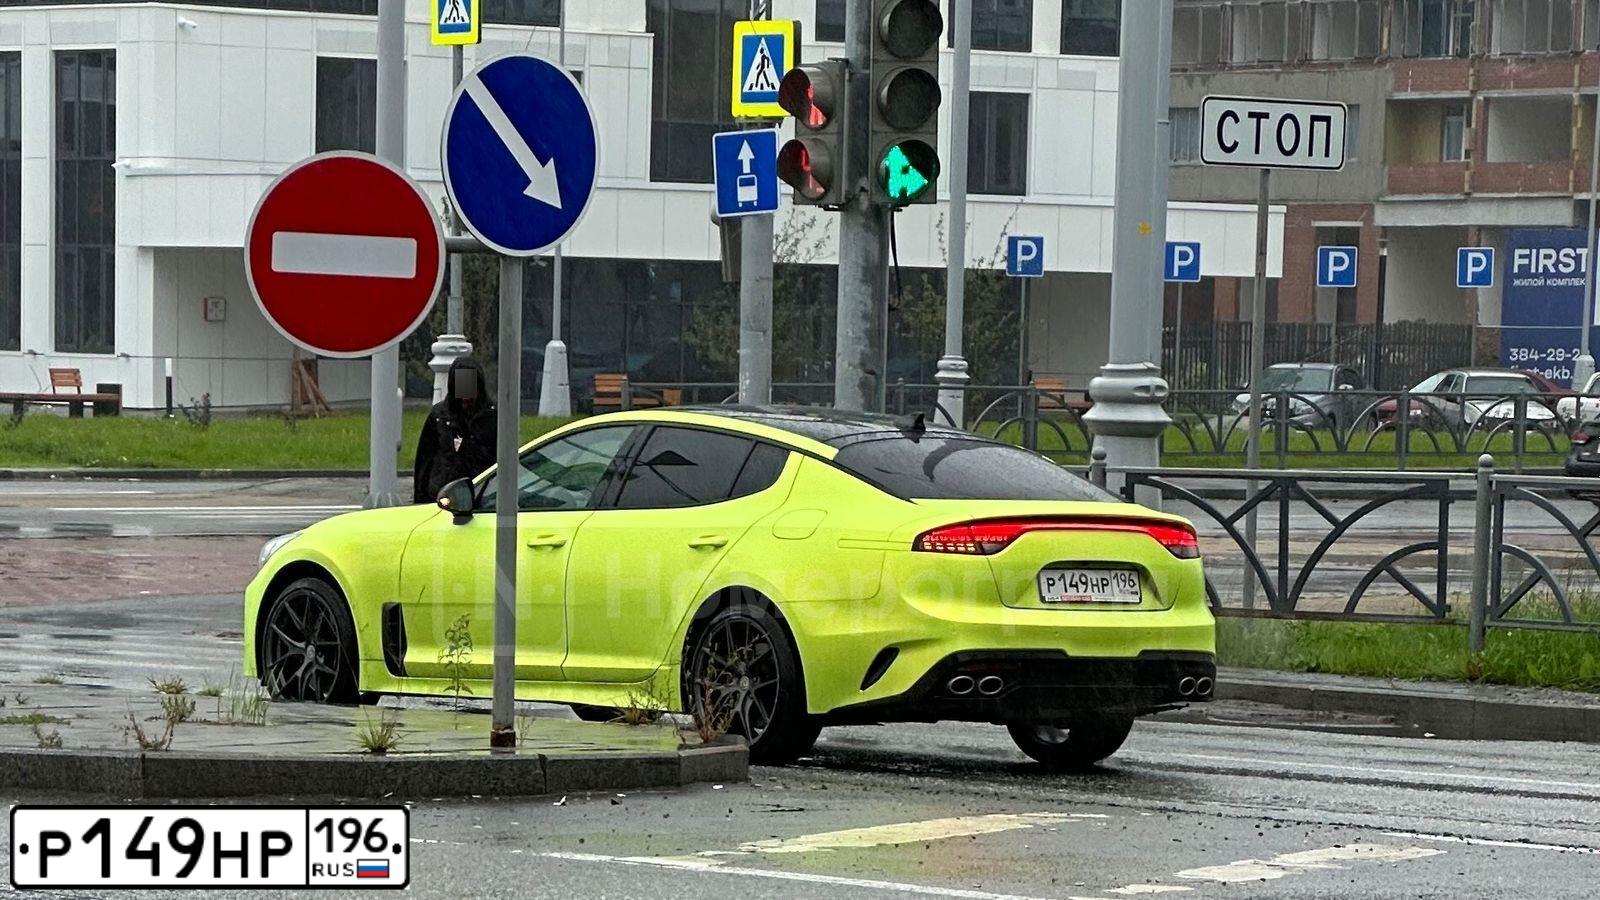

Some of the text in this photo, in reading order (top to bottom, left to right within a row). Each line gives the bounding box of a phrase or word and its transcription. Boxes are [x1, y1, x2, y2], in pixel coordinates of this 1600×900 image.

[1217, 110, 1331, 158] СТОП
[1017, 240, 1037, 271] P
[1173, 246, 1194, 276] P
[1328, 251, 1349, 282] P
[1467, 252, 1487, 282] P
[1513, 248, 1588, 273] FIRST
[1513, 277, 1586, 287] ЖИЛОЙ КОМПЛЕК
[1509, 348, 1581, 361] 384-29-2
[1046, 573, 1136, 593] Р149НР 196
